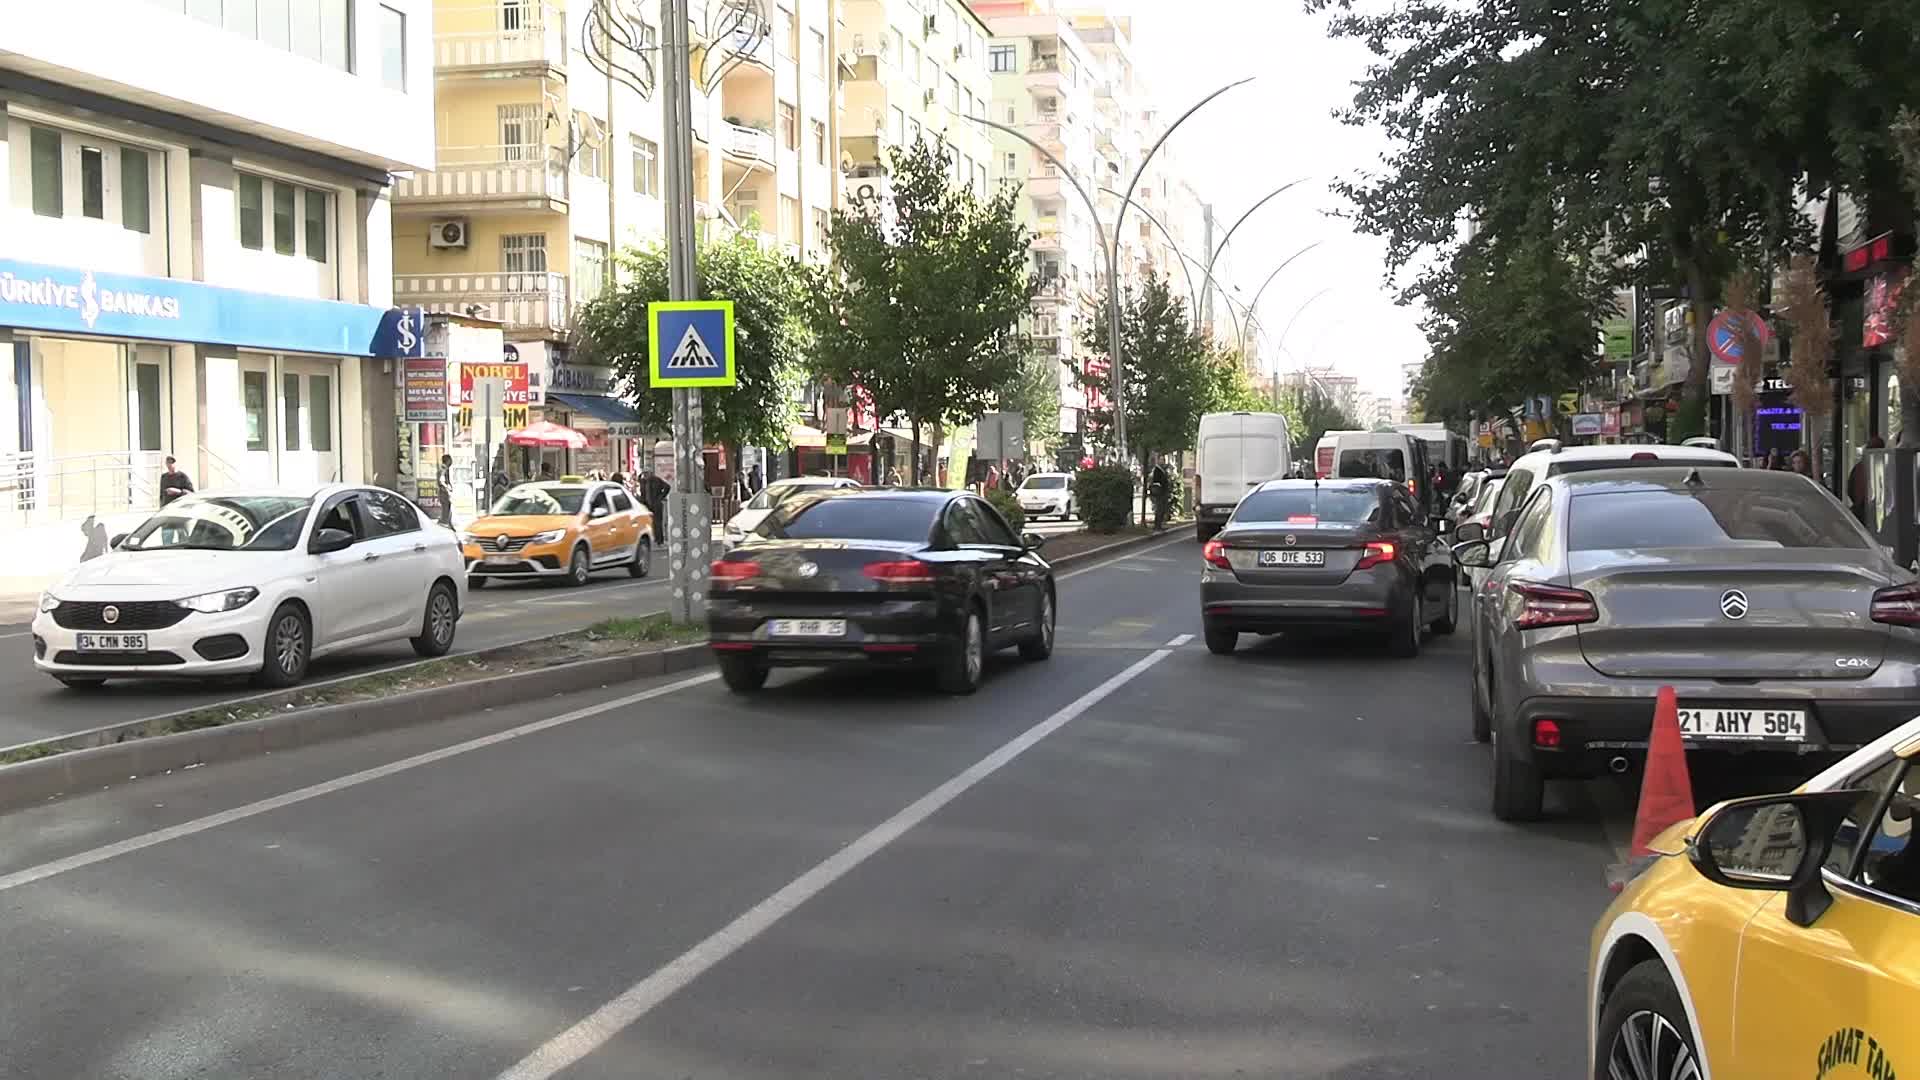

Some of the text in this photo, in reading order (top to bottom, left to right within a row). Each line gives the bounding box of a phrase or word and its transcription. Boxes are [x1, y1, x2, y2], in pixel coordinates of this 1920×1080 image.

[0, 271, 80, 309] ÜRKİYE
[463, 365, 526, 379] NOBEL
[1264, 552, 1323, 562] 06 DYE 533
[82, 635, 96, 648] 34
[123, 635, 143, 648] 985
[1678, 710, 1801, 735] 21 AHY 584
[1816, 1026, 1865, 1080] SANAT
